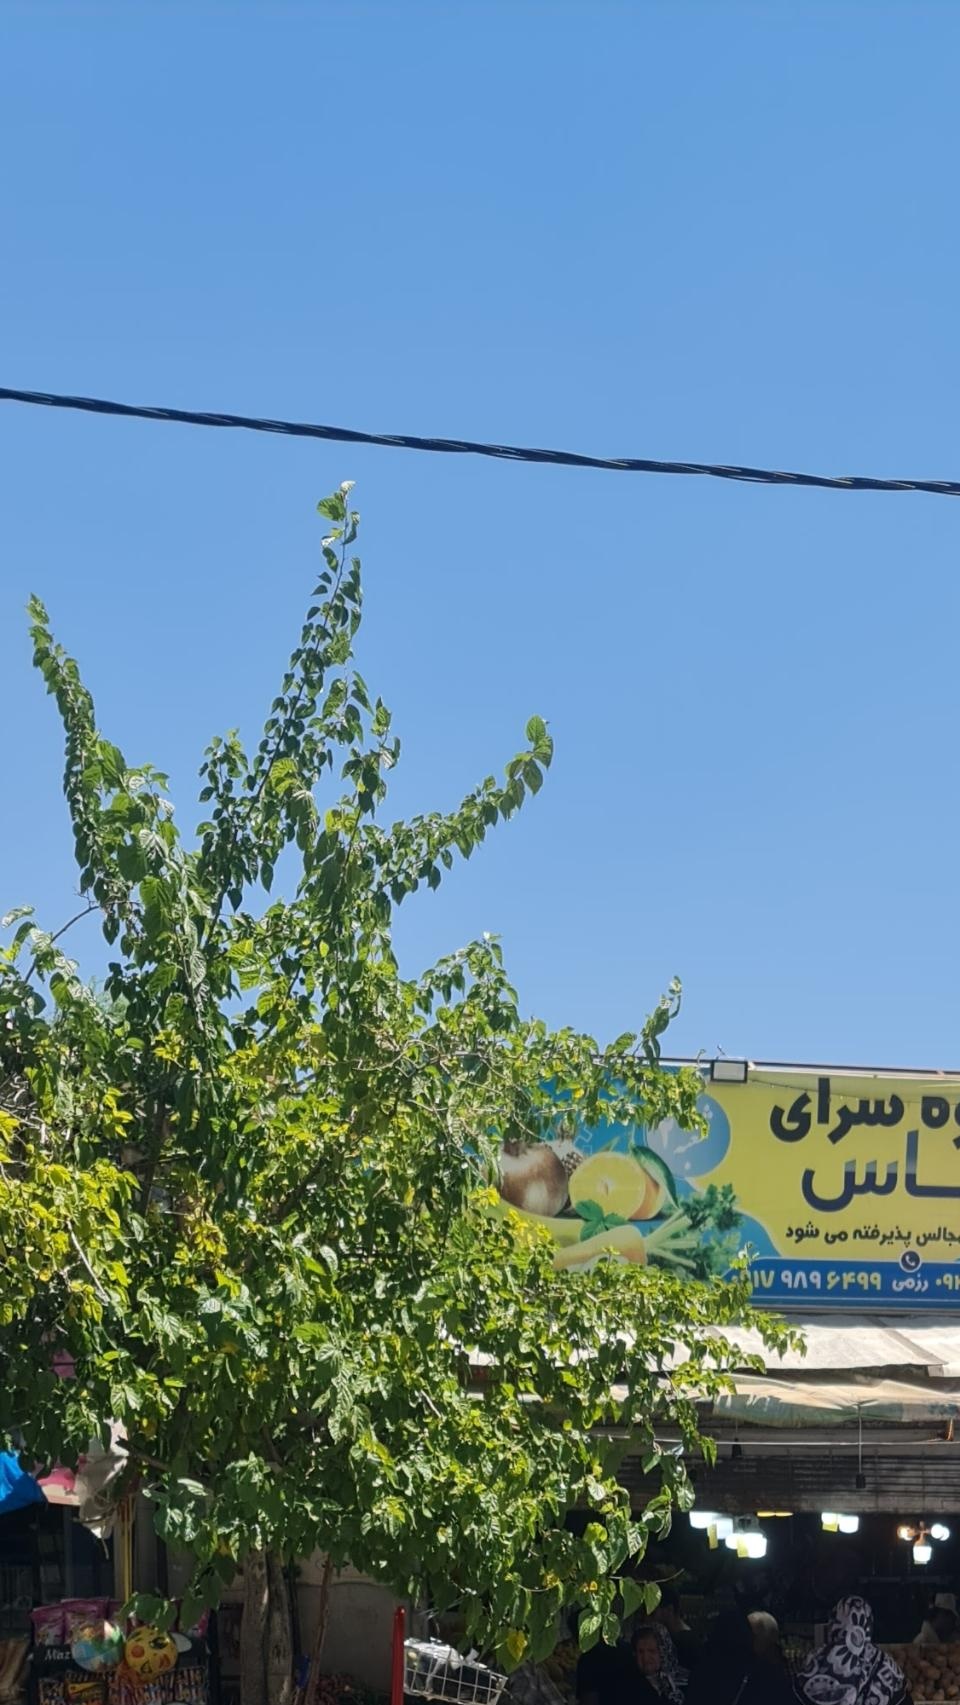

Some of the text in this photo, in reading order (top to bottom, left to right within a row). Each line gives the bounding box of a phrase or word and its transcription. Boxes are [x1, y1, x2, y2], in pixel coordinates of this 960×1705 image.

[769, 1077, 905, 1145] سرای
[785, 1221, 820, 1244] شود
[824, 1230, 849, 1244] می
[853, 1225, 912, 1248] پذیرفته
[891, 1274, 929, 1292] رزمی
[44, 1649, 69, 1661] Maz
